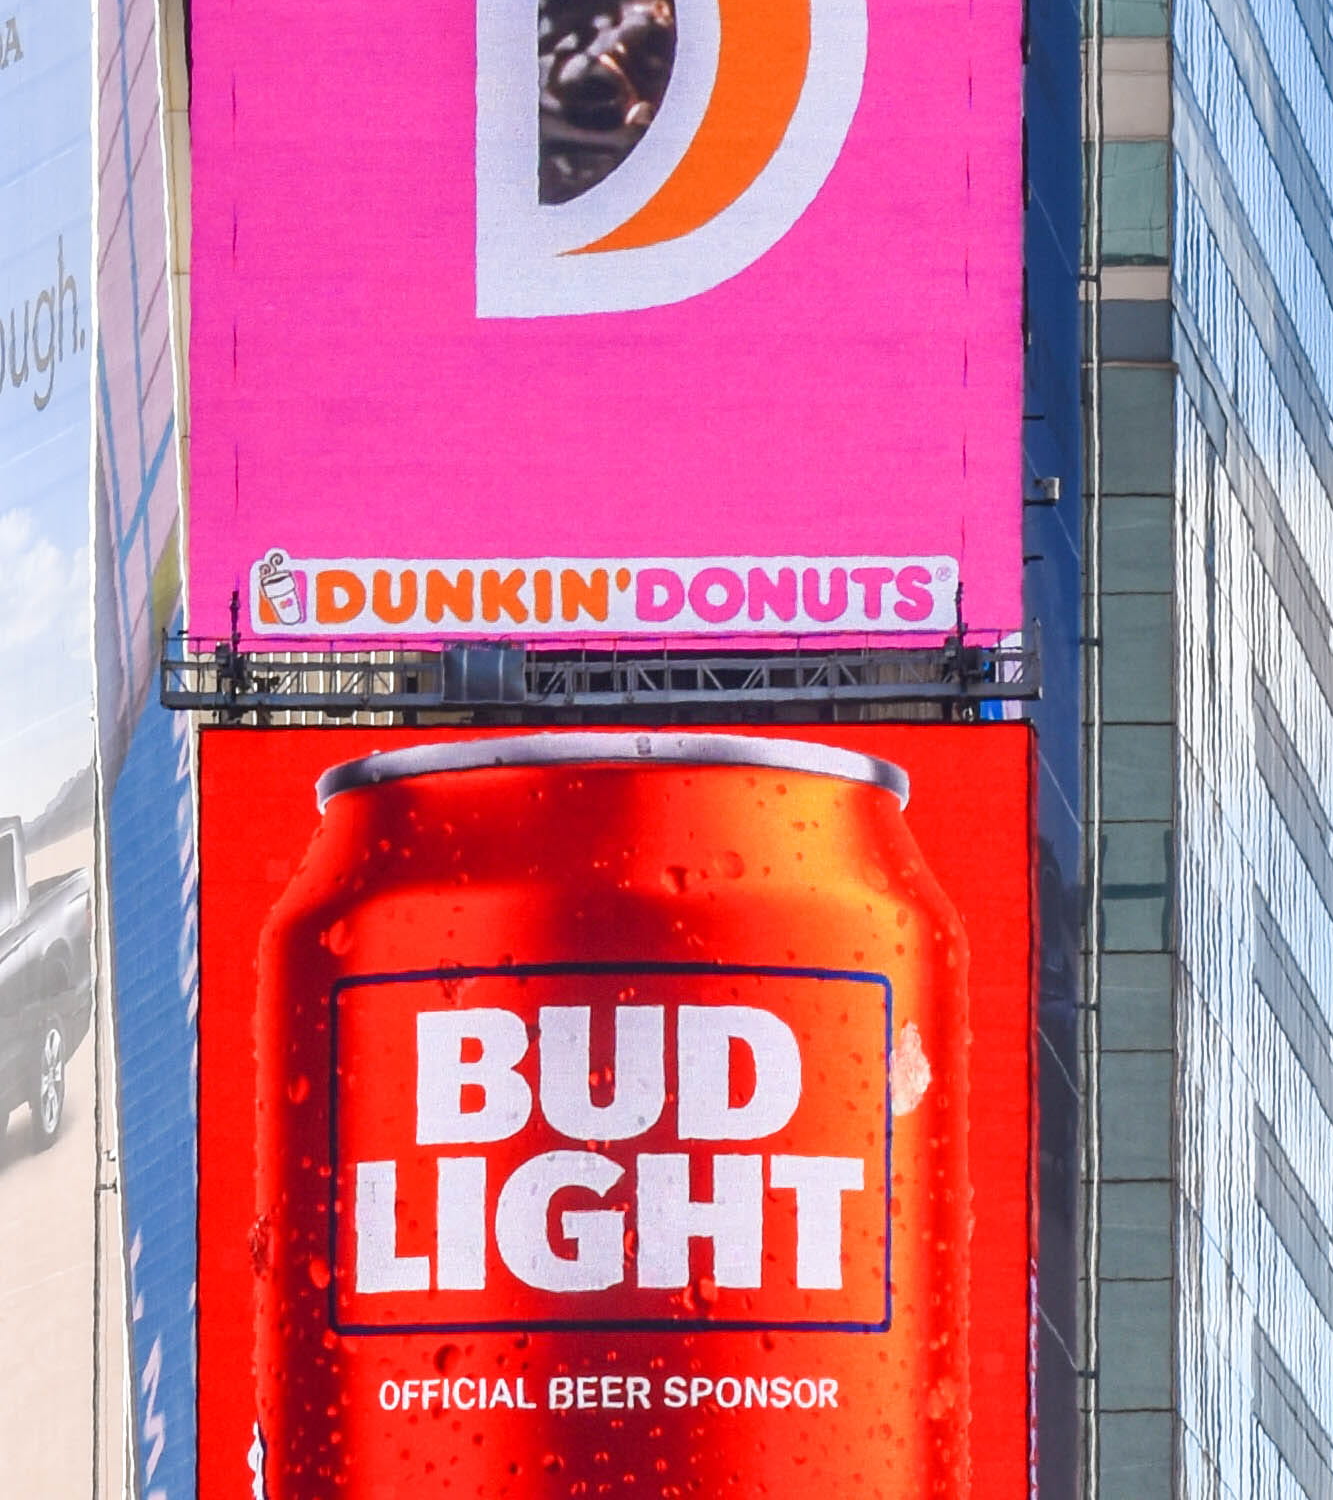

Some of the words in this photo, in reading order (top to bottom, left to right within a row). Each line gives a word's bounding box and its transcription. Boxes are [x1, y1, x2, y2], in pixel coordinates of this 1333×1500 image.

[416, 1004, 801, 1145] BUD
[355, 1151, 865, 1294] LIGHT
[378, 1377, 536, 1410] OFFICIAL
[548, 1376, 651, 1410] BEER
[663, 1375, 838, 1410] SPONSOR
